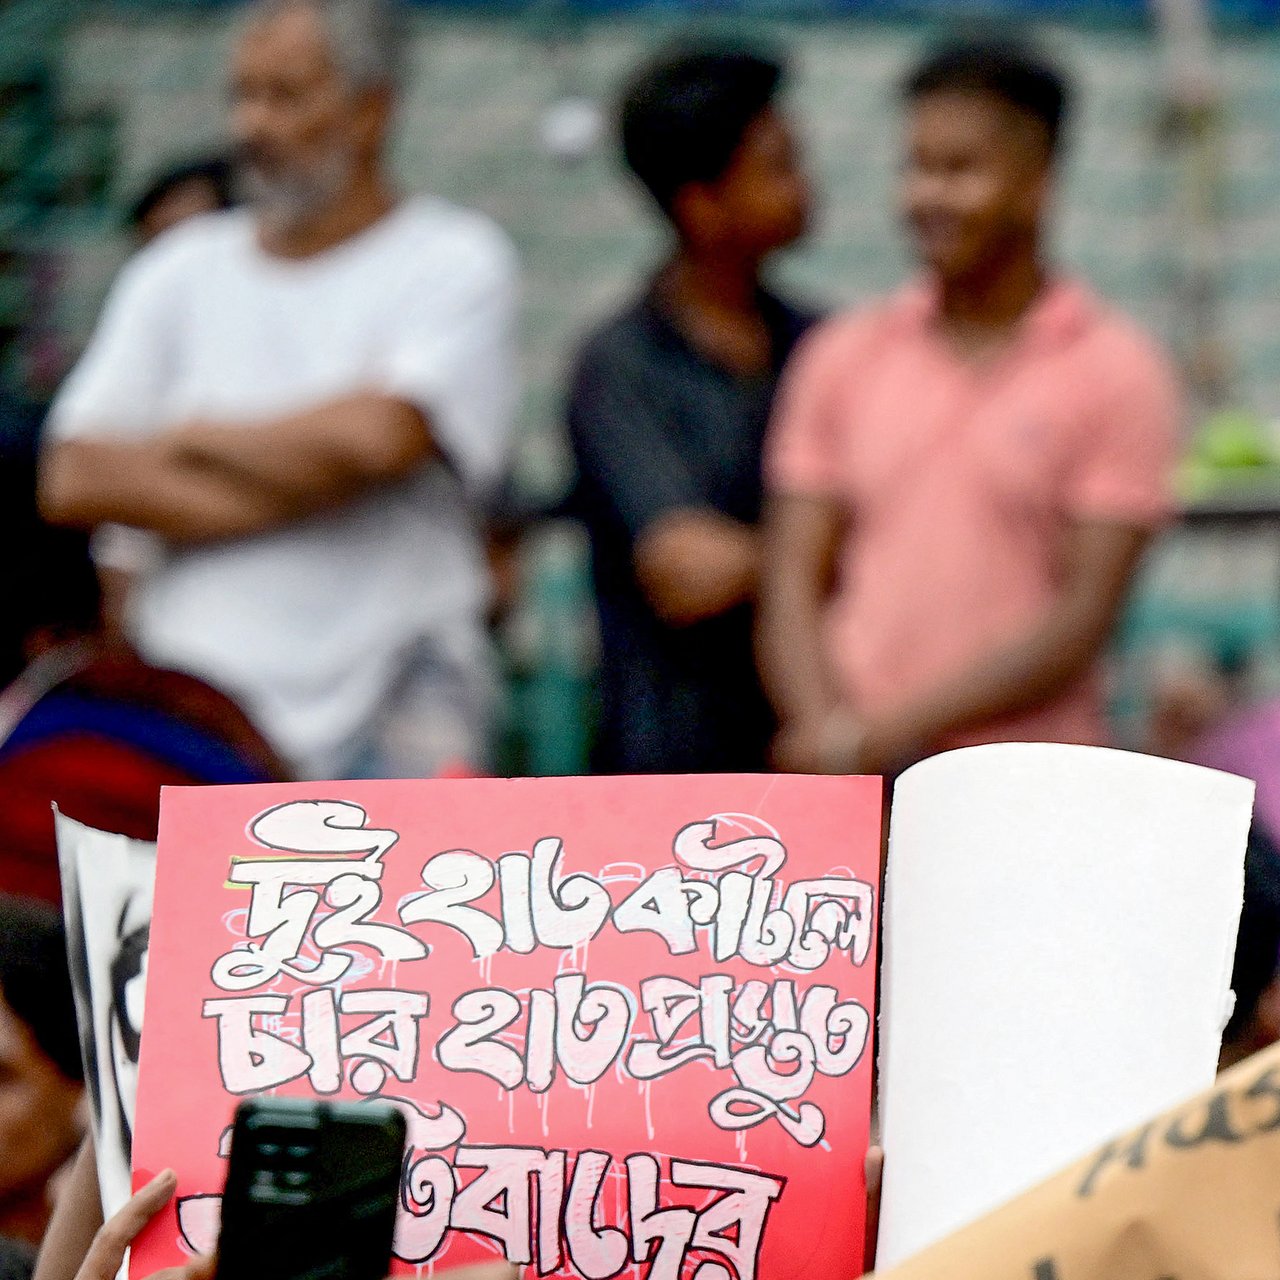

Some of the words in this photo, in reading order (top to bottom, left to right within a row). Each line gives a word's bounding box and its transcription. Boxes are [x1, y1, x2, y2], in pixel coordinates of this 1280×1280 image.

[211, 798, 430, 991] দুই
[401, 836, 610, 959] হাত
[202, 986, 429, 1095] চার
[436, 971, 638, 1092] হাত
